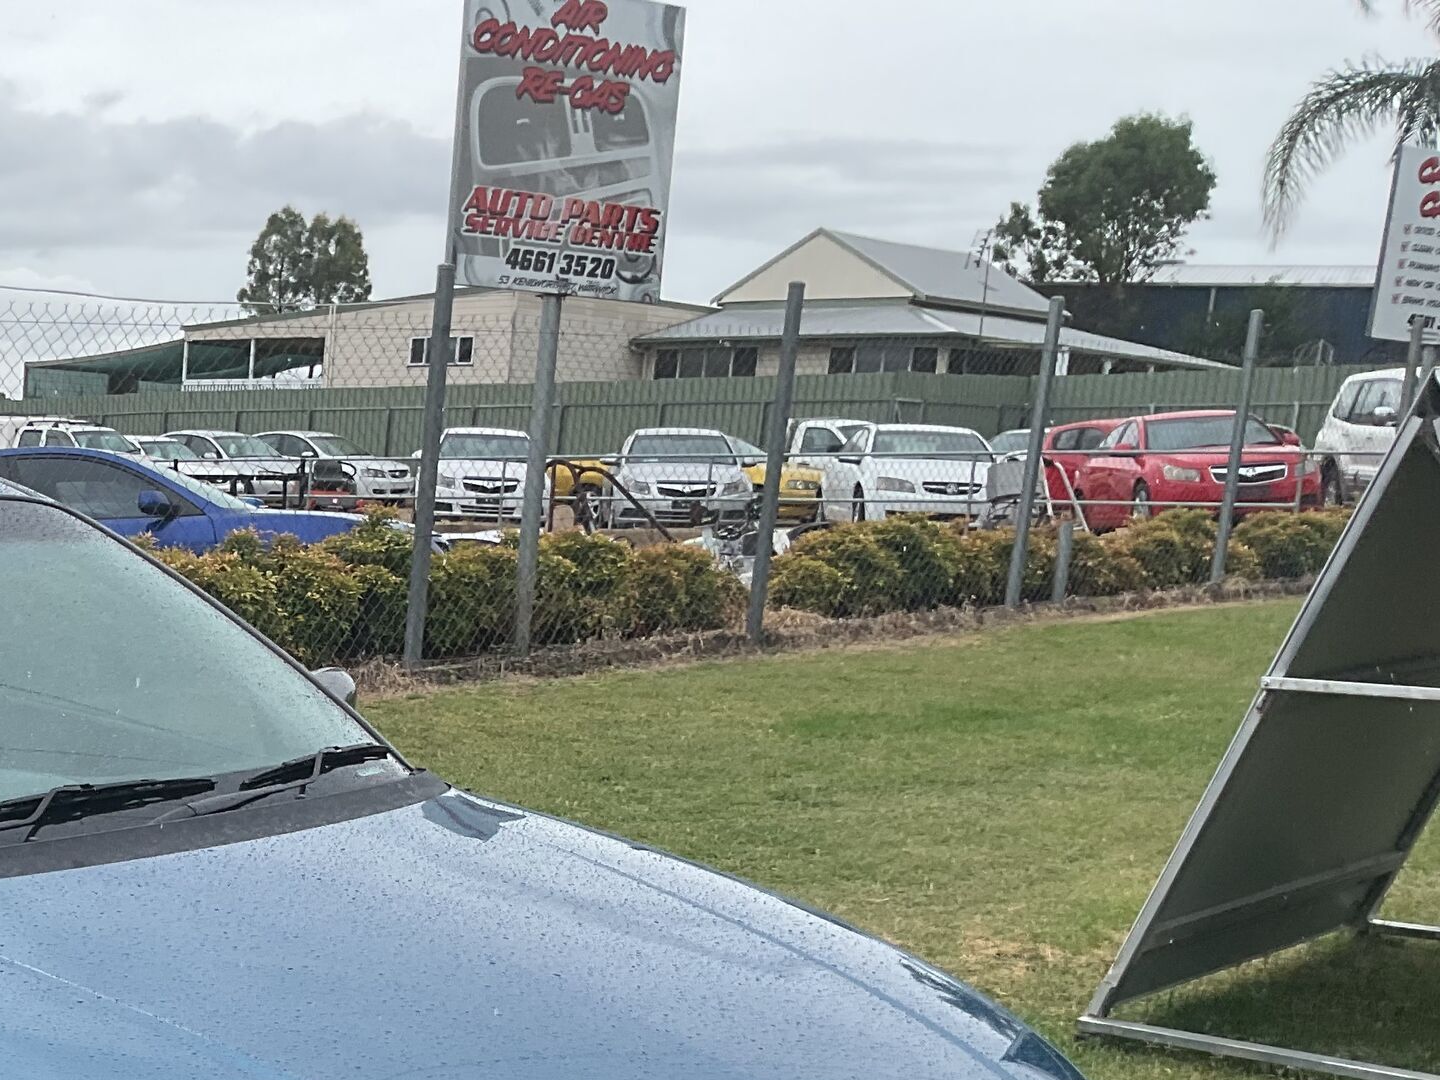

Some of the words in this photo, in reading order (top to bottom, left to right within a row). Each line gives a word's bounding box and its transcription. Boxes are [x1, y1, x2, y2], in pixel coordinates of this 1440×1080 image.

[551, 0, 608, 35] AIR
[474, 17, 675, 86] CONDITIONING
[516, 66, 630, 115] RE-GAS
[463, 186, 554, 221] AUTO
[561, 198, 661, 235] PARTS
[462, 213, 563, 244] SERVICE
[568, 224, 657, 254] CENTRE
[498, 275, 510, 284] 53
[505, 248, 557, 274] 4661
[559, 252, 616, 280] 3520
